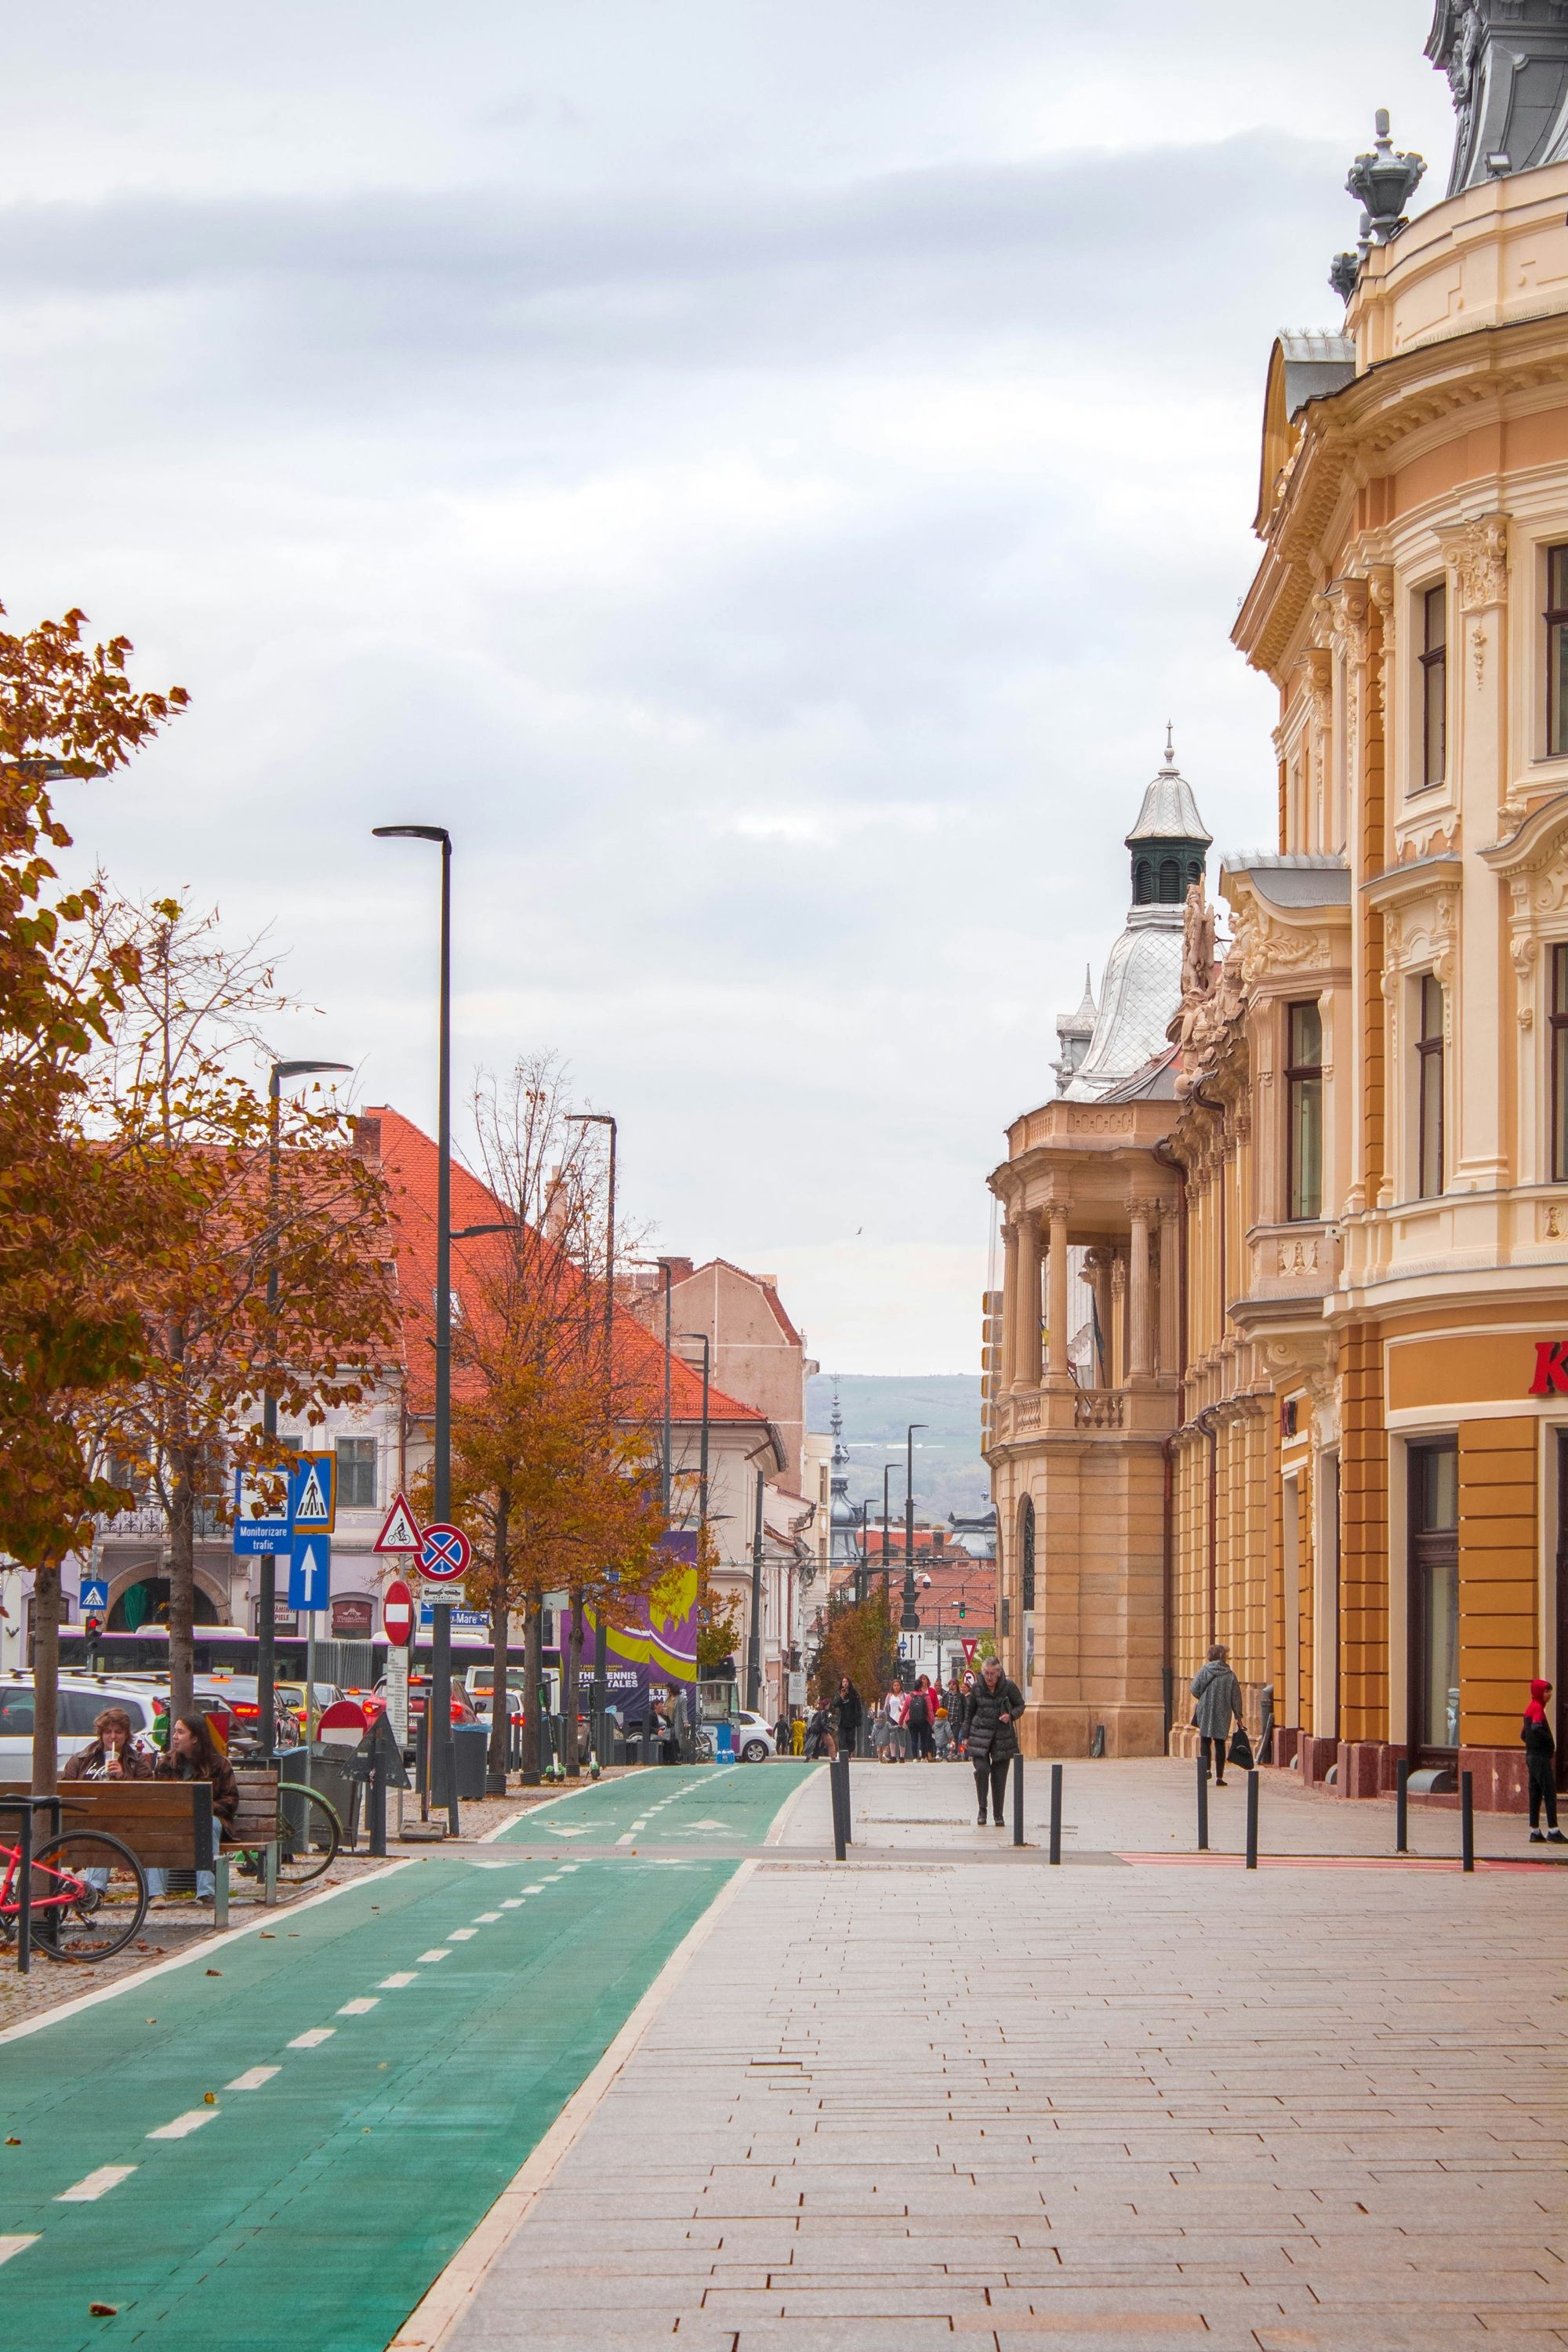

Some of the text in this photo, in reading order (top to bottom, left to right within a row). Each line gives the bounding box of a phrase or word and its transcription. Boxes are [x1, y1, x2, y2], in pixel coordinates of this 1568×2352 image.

[240, 1526, 287, 1537] Monitorizare
[253, 1539, 274, 1550] trafic
[456, 1613, 477, 1624] Mare
